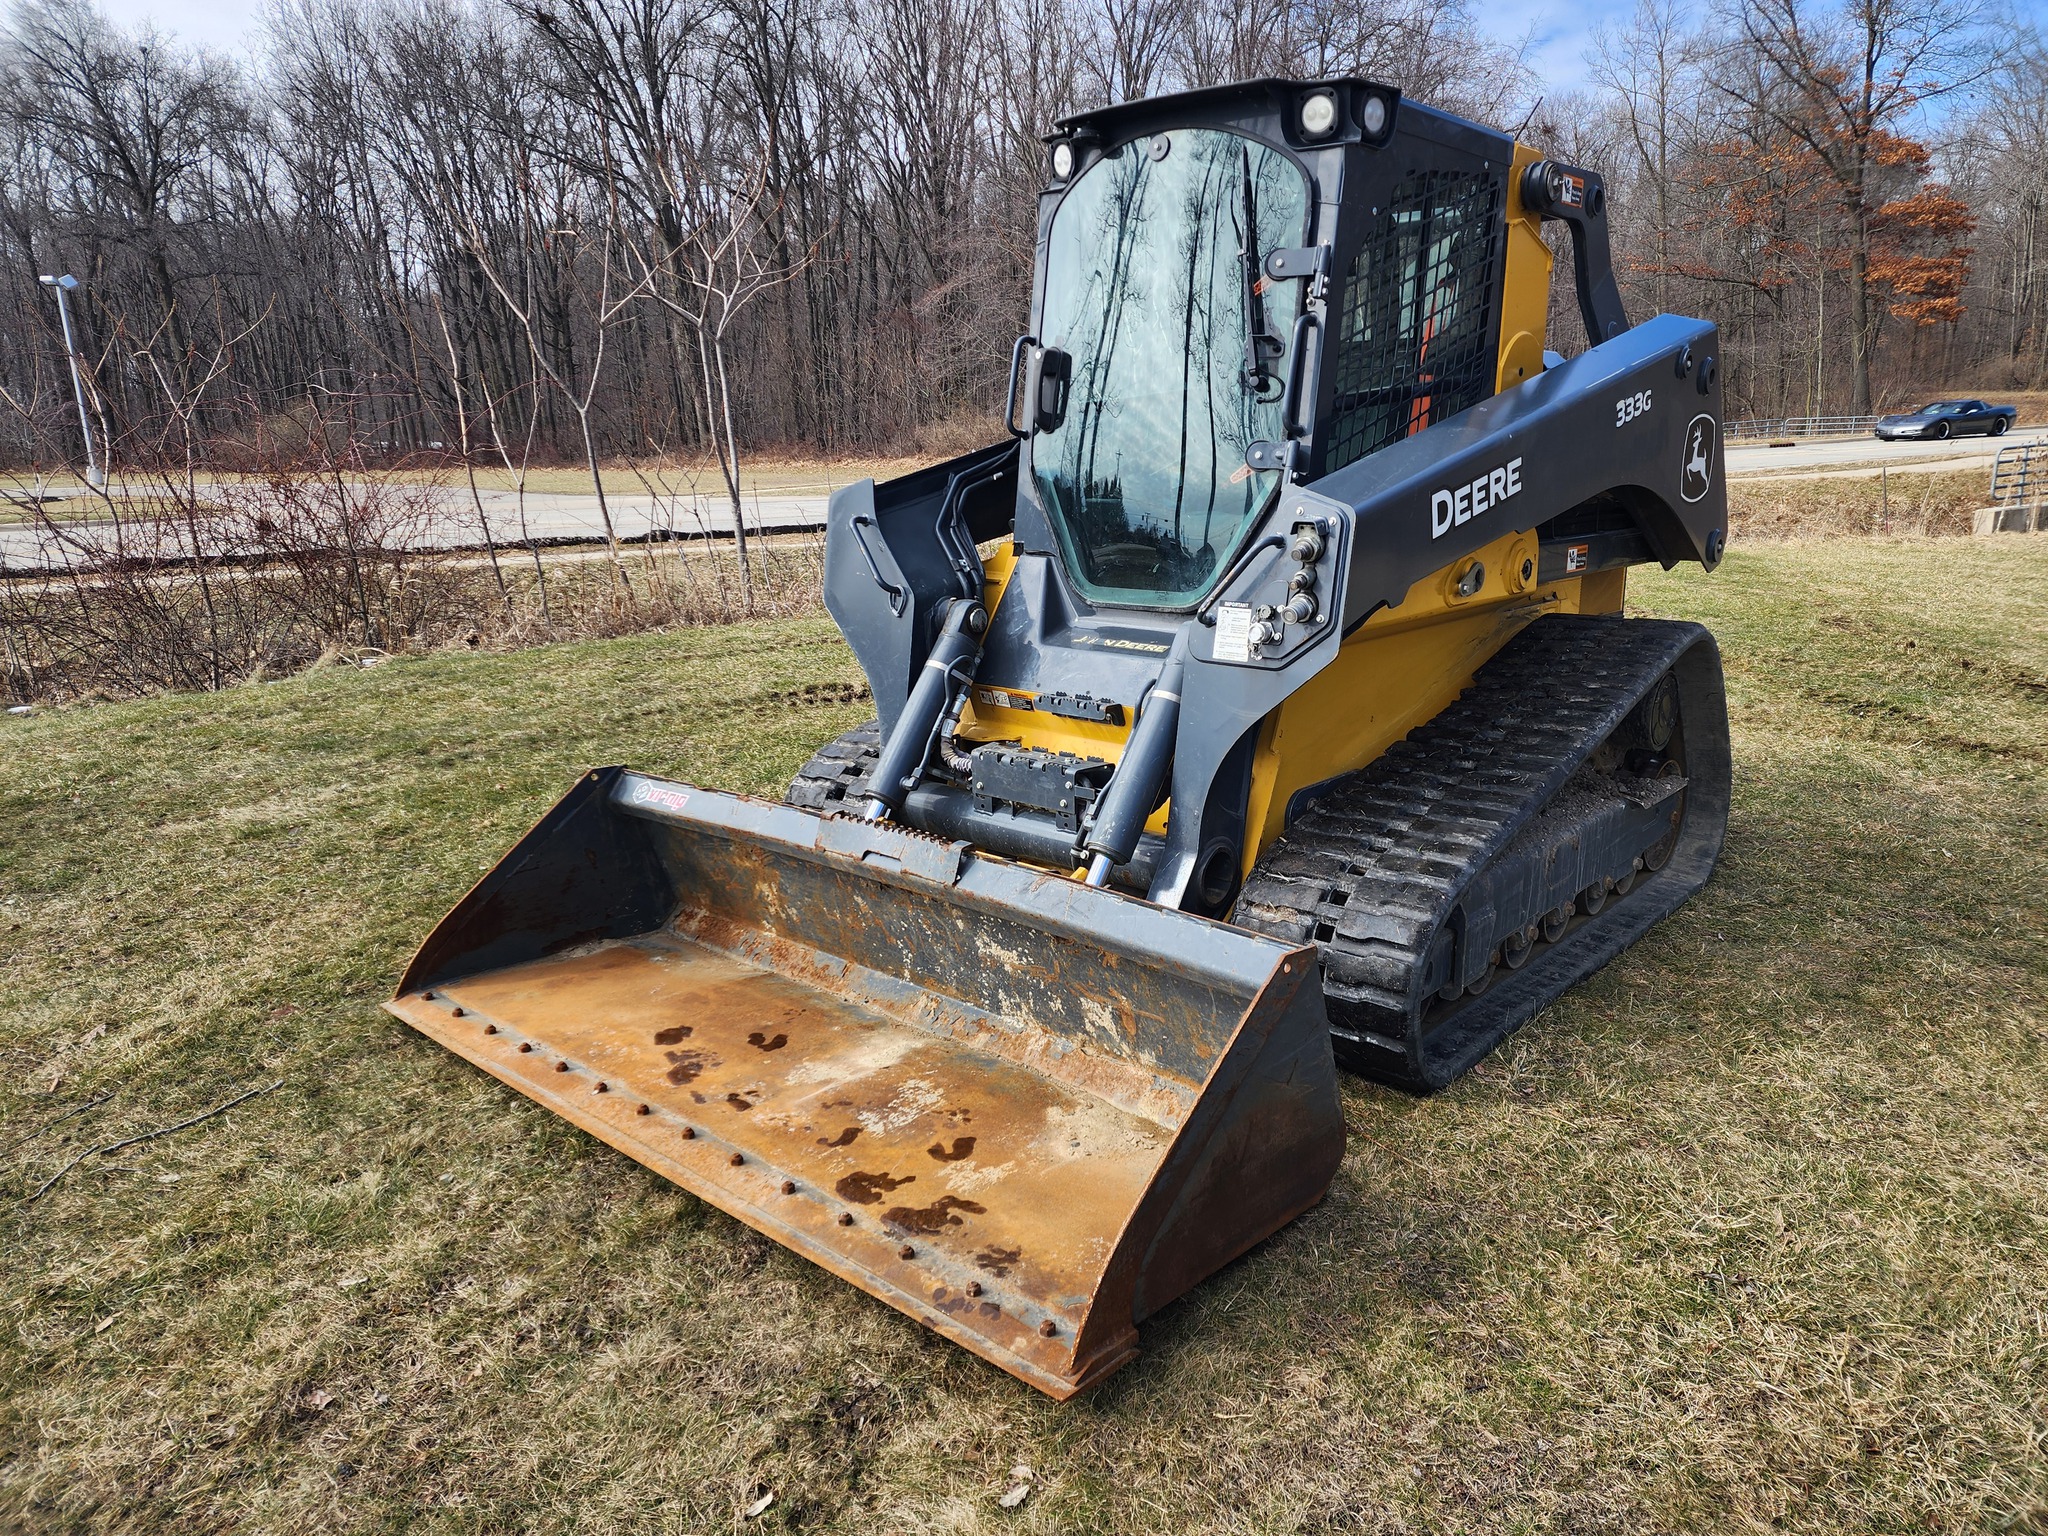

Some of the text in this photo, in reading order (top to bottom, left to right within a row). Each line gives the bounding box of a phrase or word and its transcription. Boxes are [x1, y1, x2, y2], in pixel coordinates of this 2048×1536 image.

[1616, 389, 1652, 428] 333G
[1431, 456, 1522, 540] DEERE
[1114, 640, 1171, 653] DEERE
